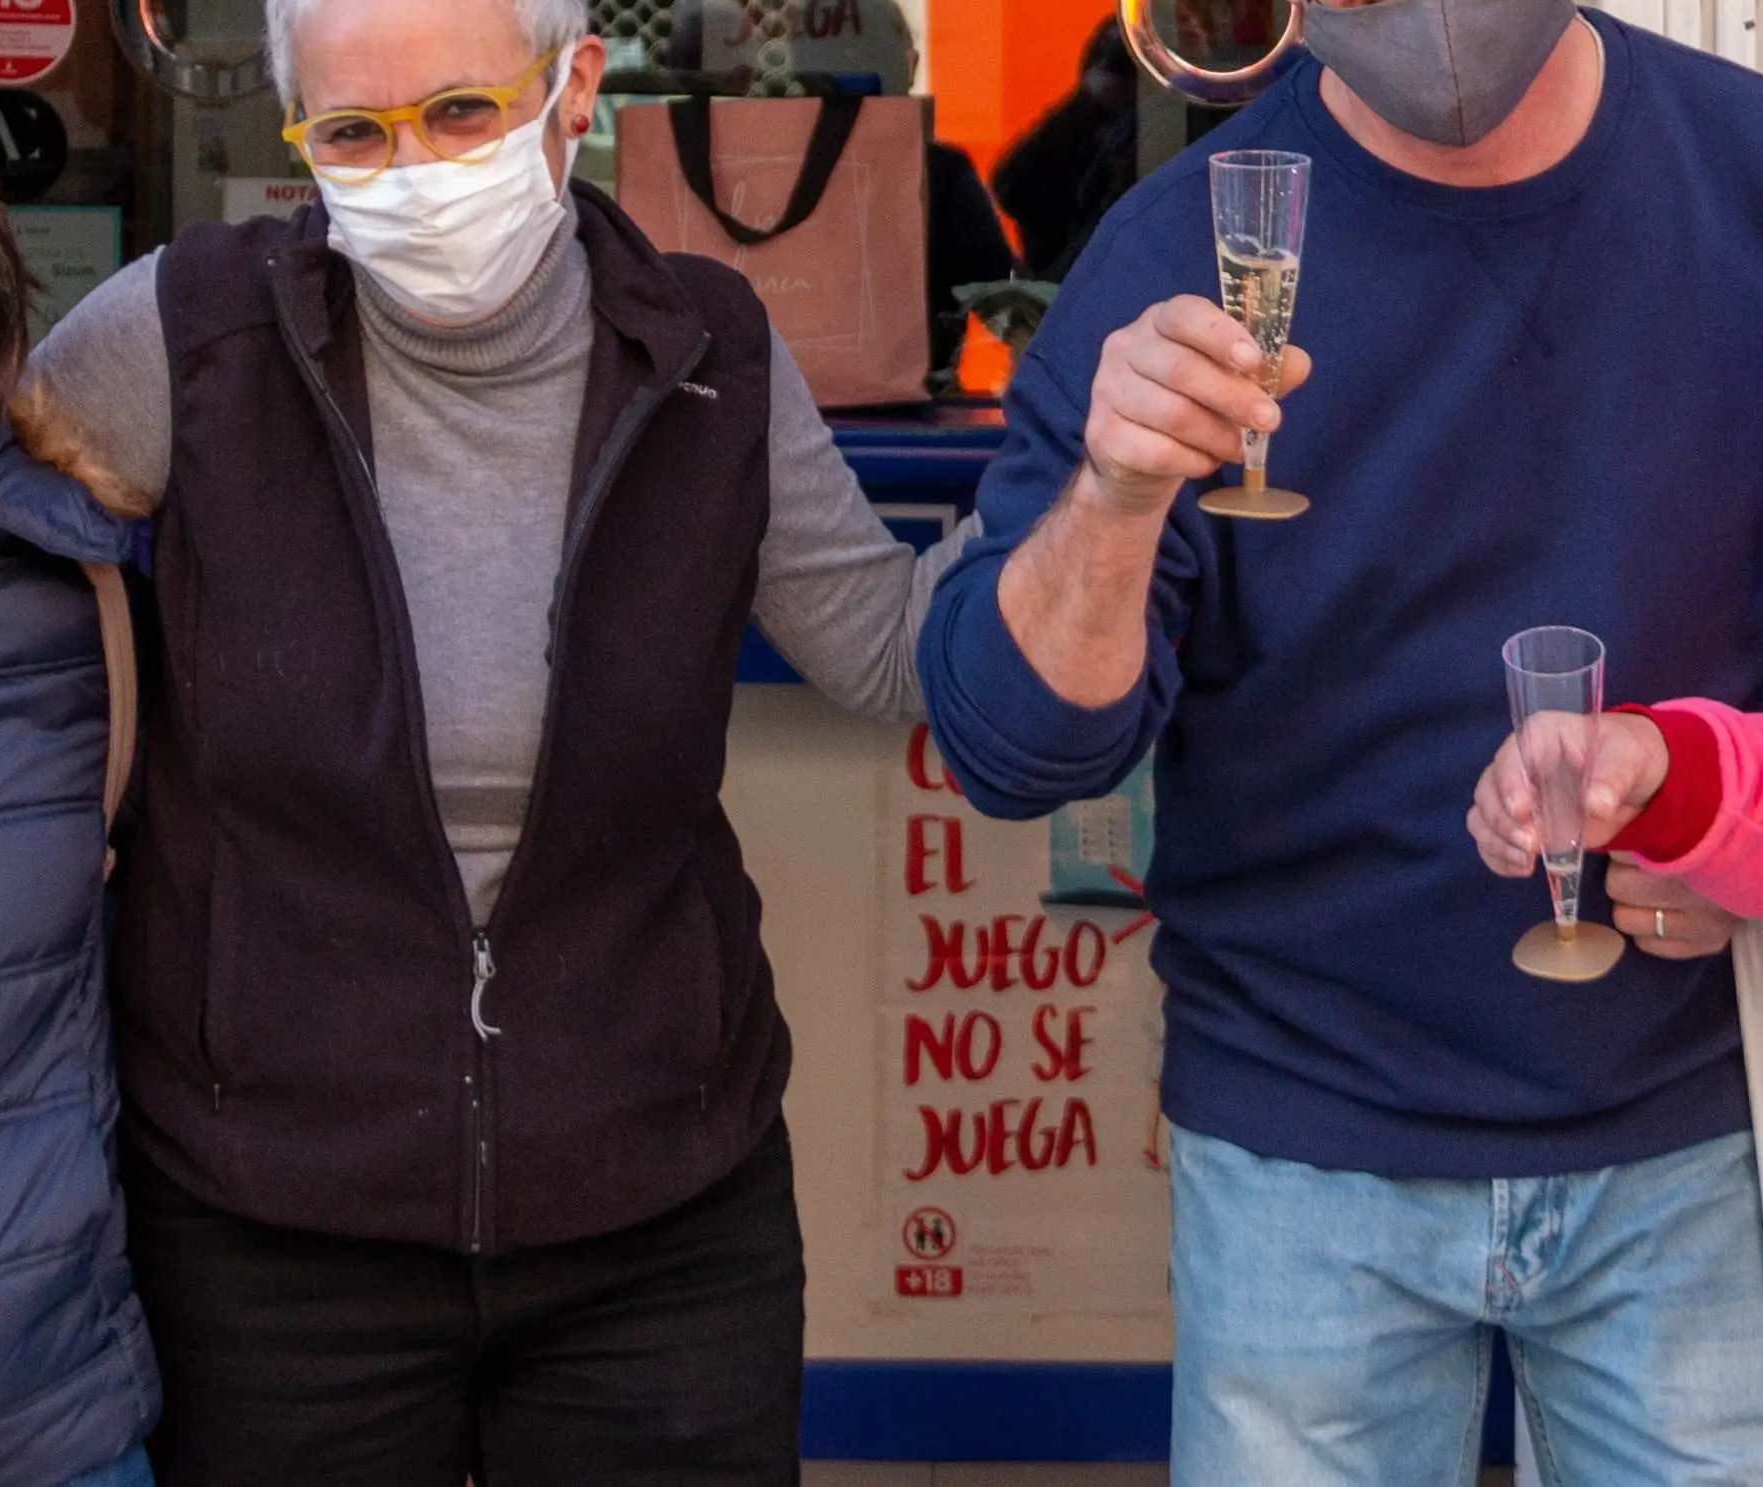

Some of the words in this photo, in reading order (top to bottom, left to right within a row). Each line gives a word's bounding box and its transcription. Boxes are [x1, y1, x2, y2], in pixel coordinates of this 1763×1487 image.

[904, 813, 977, 896] EL
[904, 913, 1107, 993] JUEGO
[903, 1009, 1003, 1087] NO
[1031, 1003, 1098, 1082] SE
[903, 1095, 1098, 1182] JUEGA
[903, 1267, 954, 1293] +18
